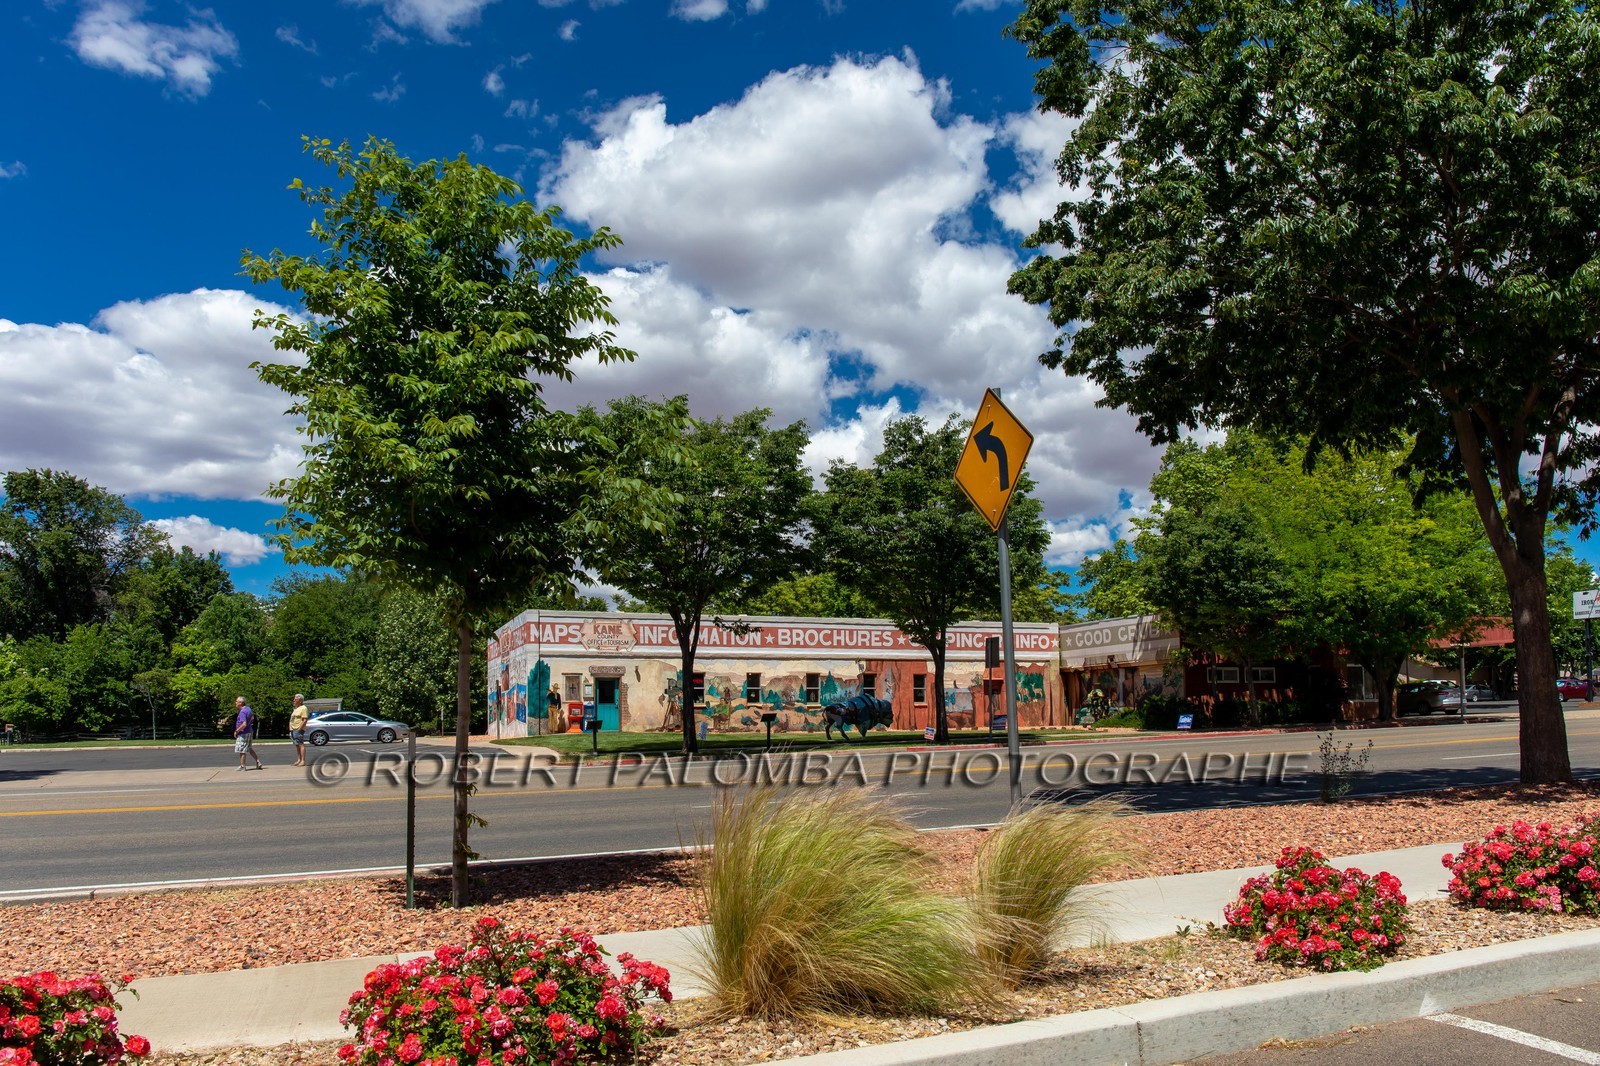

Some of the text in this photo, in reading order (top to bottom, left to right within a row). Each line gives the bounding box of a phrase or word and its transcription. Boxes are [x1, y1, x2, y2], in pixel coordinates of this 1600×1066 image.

[530, 623, 582, 643] MAPS
[593, 624, 623, 635] KANE
[639, 626, 761, 646] INFOMATION
[777, 628, 893, 647] BROCHURES
[1015, 634, 1050, 650] INFO
[1075, 628, 1112, 647] GOOD
